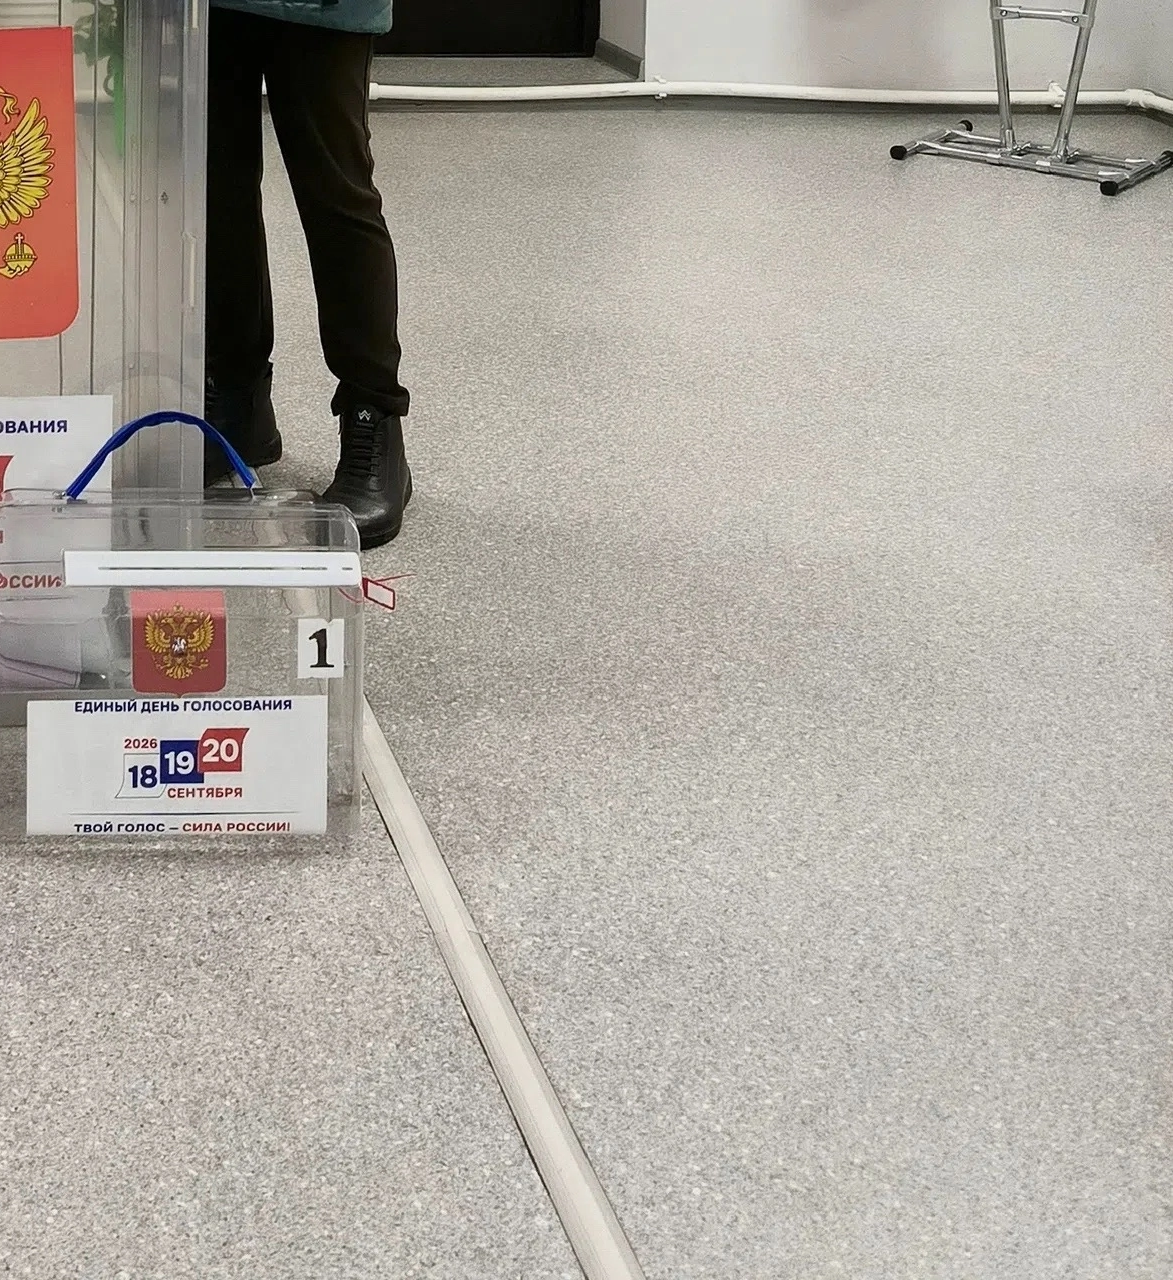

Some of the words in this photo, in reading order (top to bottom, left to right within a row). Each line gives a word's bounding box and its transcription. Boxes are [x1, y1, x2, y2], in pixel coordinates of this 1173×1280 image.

[308, 628, 334, 668] 1
[75, 699, 136, 713] ЕДИНЫЙ
[141, 701, 179, 713] ДЕНЬ
[183, 700, 292, 711] ГОЛОСОВАНИЯ
[124, 738, 157, 749] 2026
[128, 765, 158, 788] 18
[164, 751, 194, 774] 19
[202, 738, 239, 762] 20
[167, 787, 243, 798] СЕНТЯБРЯ
[74, 821, 113, 832] ТВОЙ
[117, 823, 165, 832] ГОЛОС
[182, 822, 222, 832] СИЛА
[227, 821, 290, 832] РОССИИ!
